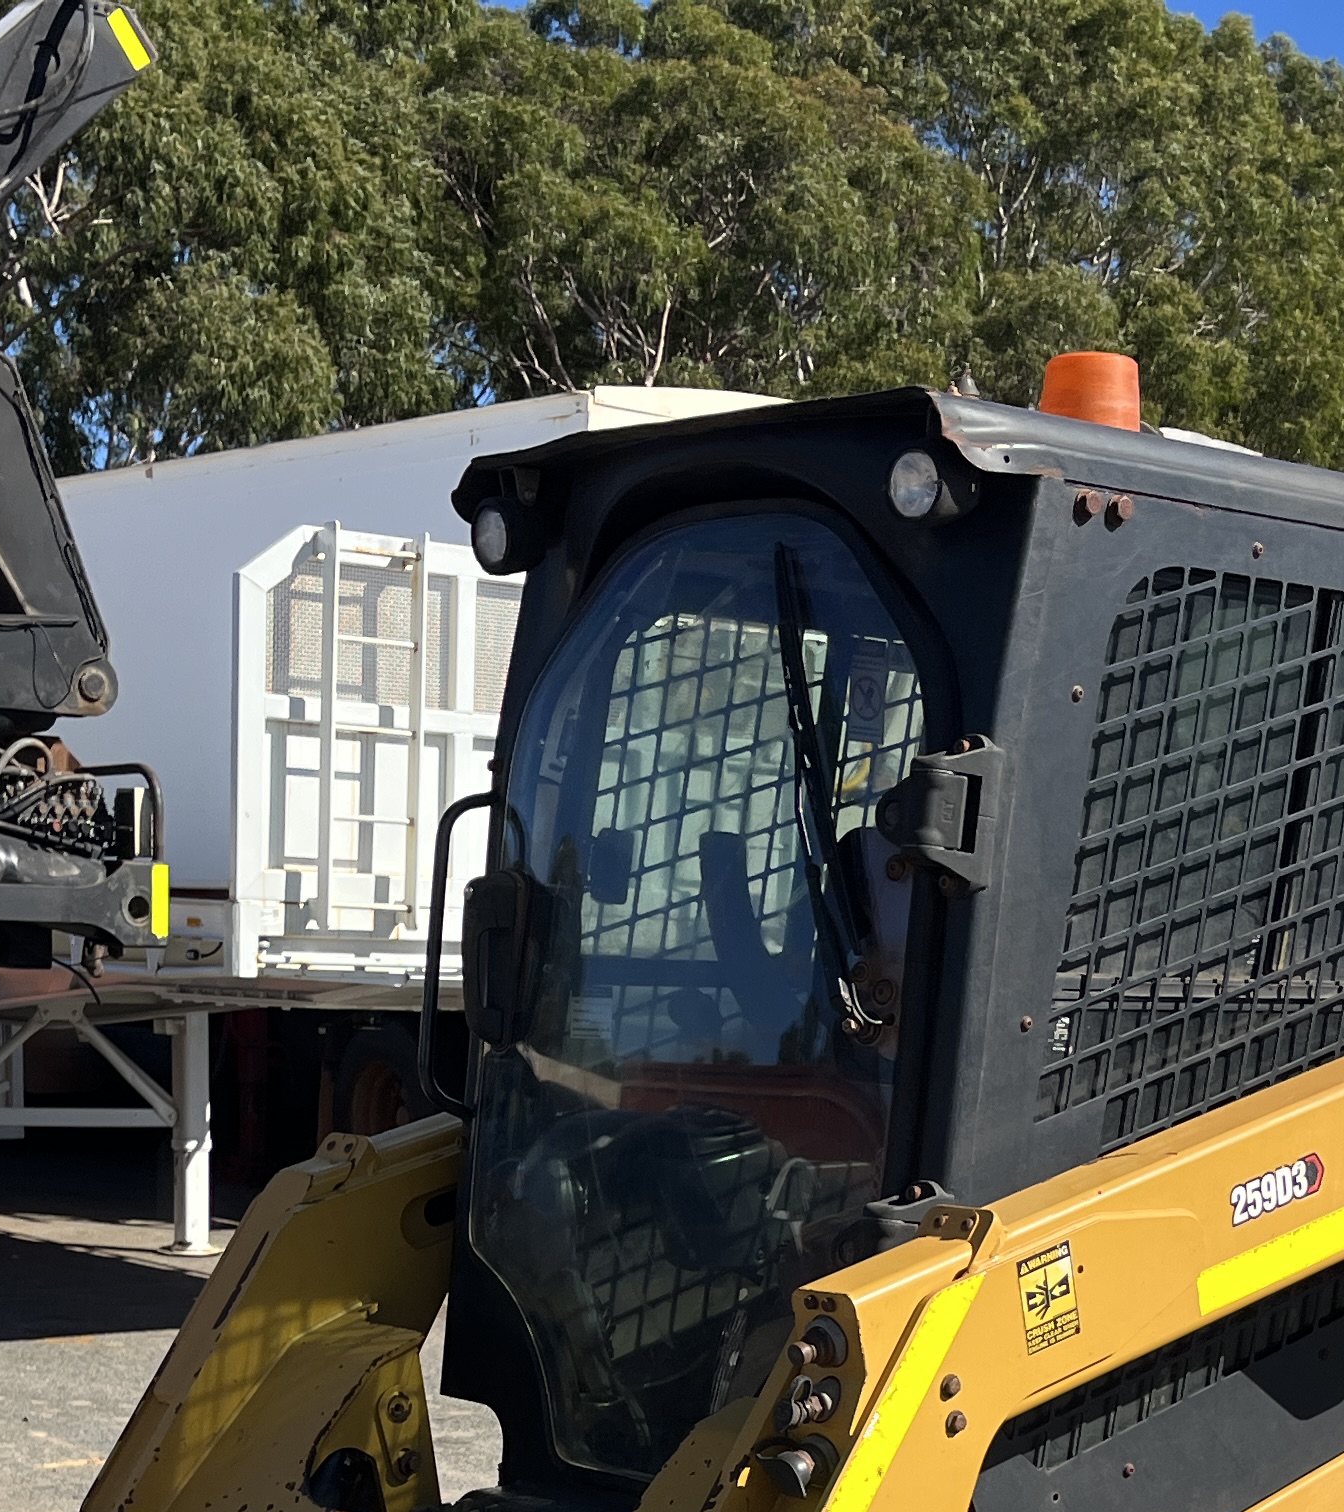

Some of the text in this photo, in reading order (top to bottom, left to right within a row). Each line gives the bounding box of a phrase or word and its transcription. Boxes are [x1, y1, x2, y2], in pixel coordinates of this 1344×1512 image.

[1229, 1158, 1309, 1227] 259D3
[1026, 1244, 1069, 1271] WARNING
[1026, 1321, 1055, 1340] CRUSH
[1056, 1310, 1078, 1329] ZONE
